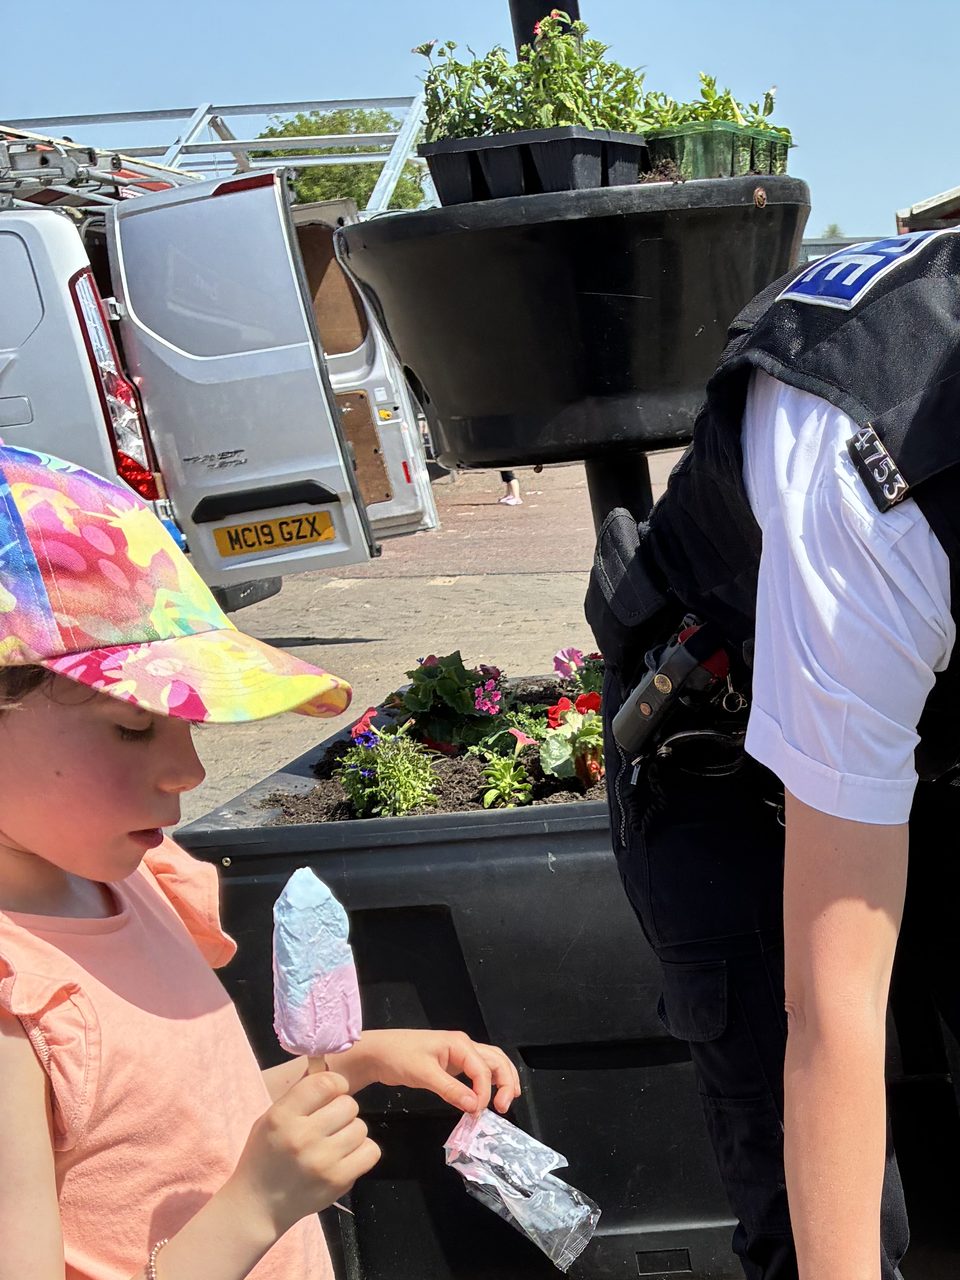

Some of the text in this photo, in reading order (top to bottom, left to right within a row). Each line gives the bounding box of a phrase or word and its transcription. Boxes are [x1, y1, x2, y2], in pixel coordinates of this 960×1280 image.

[855, 428, 906, 500] 4753
[226, 516, 322, 551] MC19 GZX
